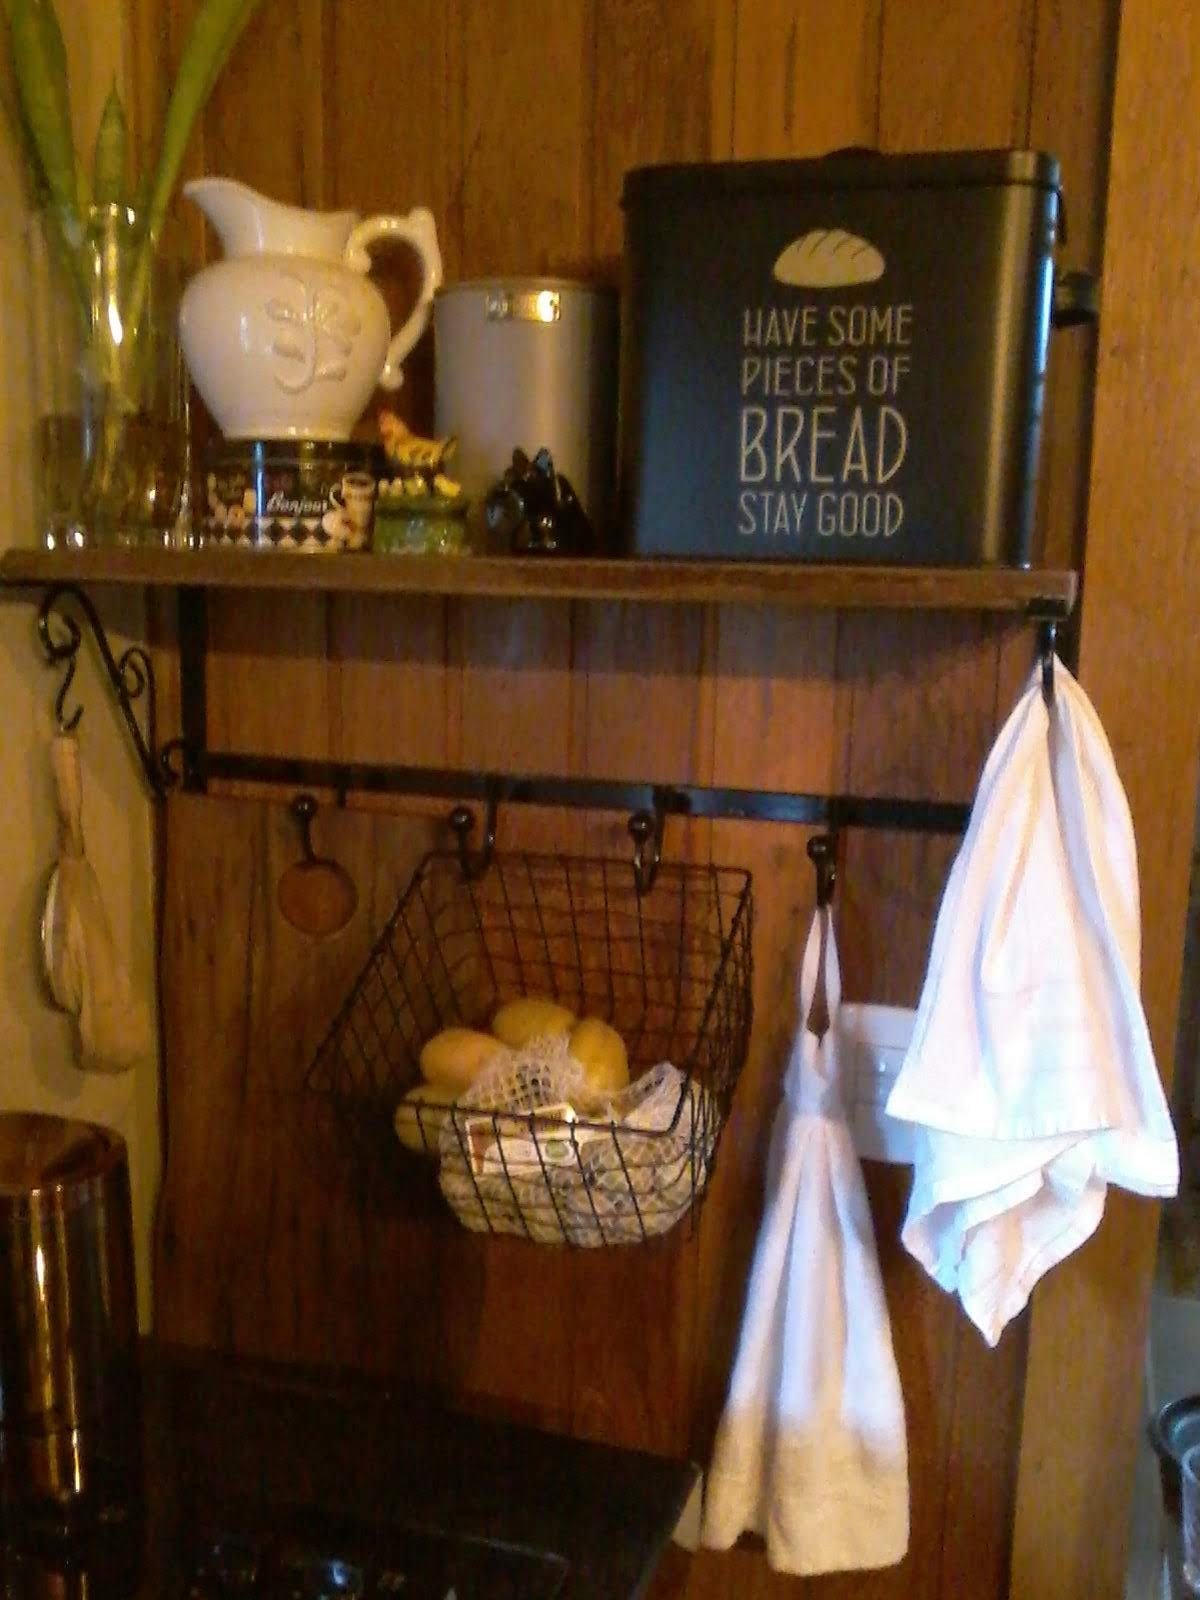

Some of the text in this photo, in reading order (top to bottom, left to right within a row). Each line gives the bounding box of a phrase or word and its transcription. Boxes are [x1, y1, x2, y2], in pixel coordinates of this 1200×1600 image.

[743, 303, 913, 347] HAVE SOME
[741, 355, 912, 396] PIECES OF
[740, 405, 908, 484] BREAD
[738, 491, 905, 537] STAY GOOD
